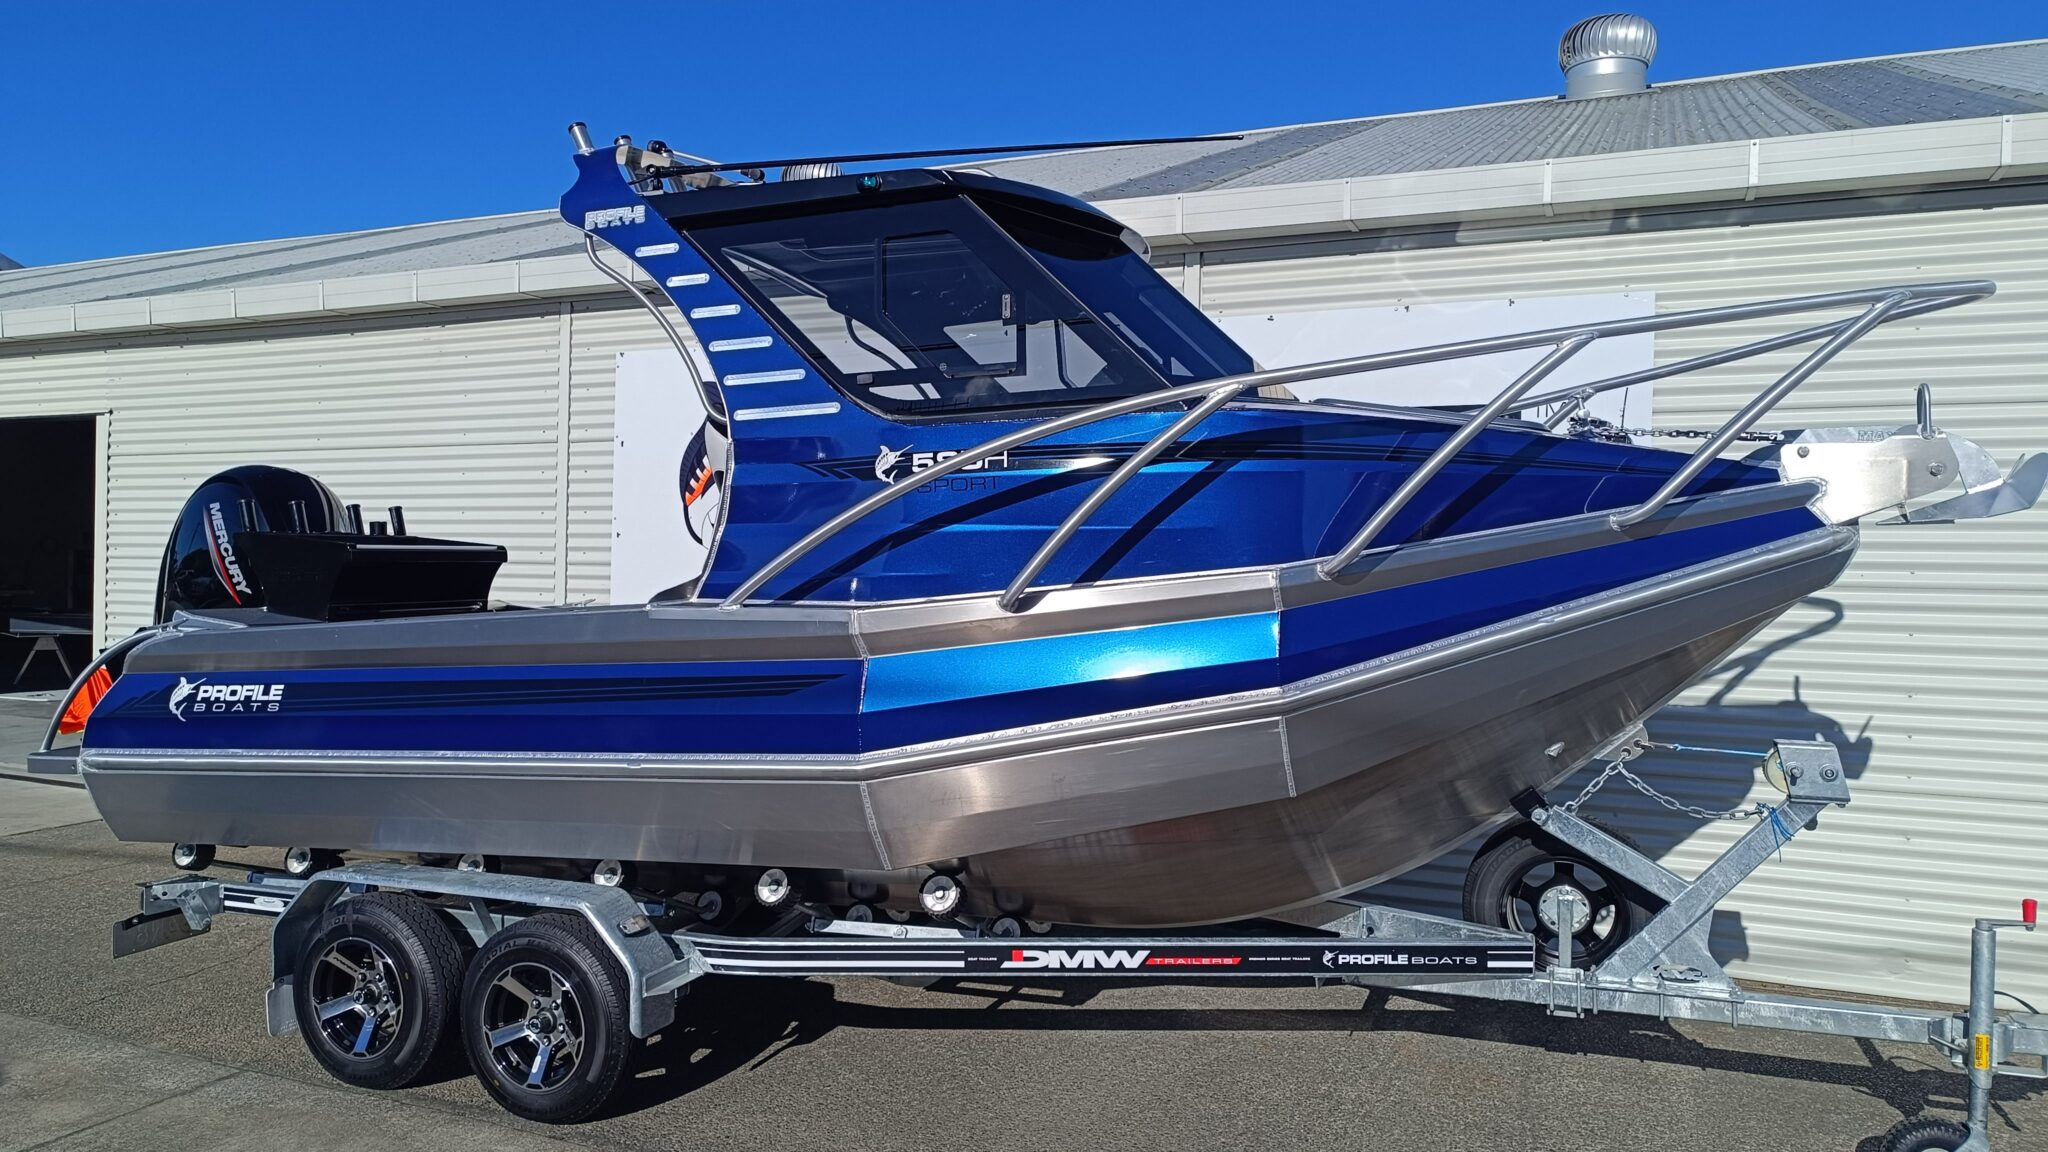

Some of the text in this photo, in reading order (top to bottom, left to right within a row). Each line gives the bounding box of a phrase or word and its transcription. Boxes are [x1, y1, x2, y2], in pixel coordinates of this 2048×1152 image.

[585, 205, 645, 222] PROFILE
[917, 476, 1001, 493] SPORT
[210, 502, 252, 594] MERCURY
[197, 684, 285, 701] PROFILE
[193, 703, 280, 712] BOATS
[1000, 949, 1150, 968] DMW
[1155, 957, 1233, 965] TRAILERS
[1338, 954, 1477, 965] PROFILE BOATS
